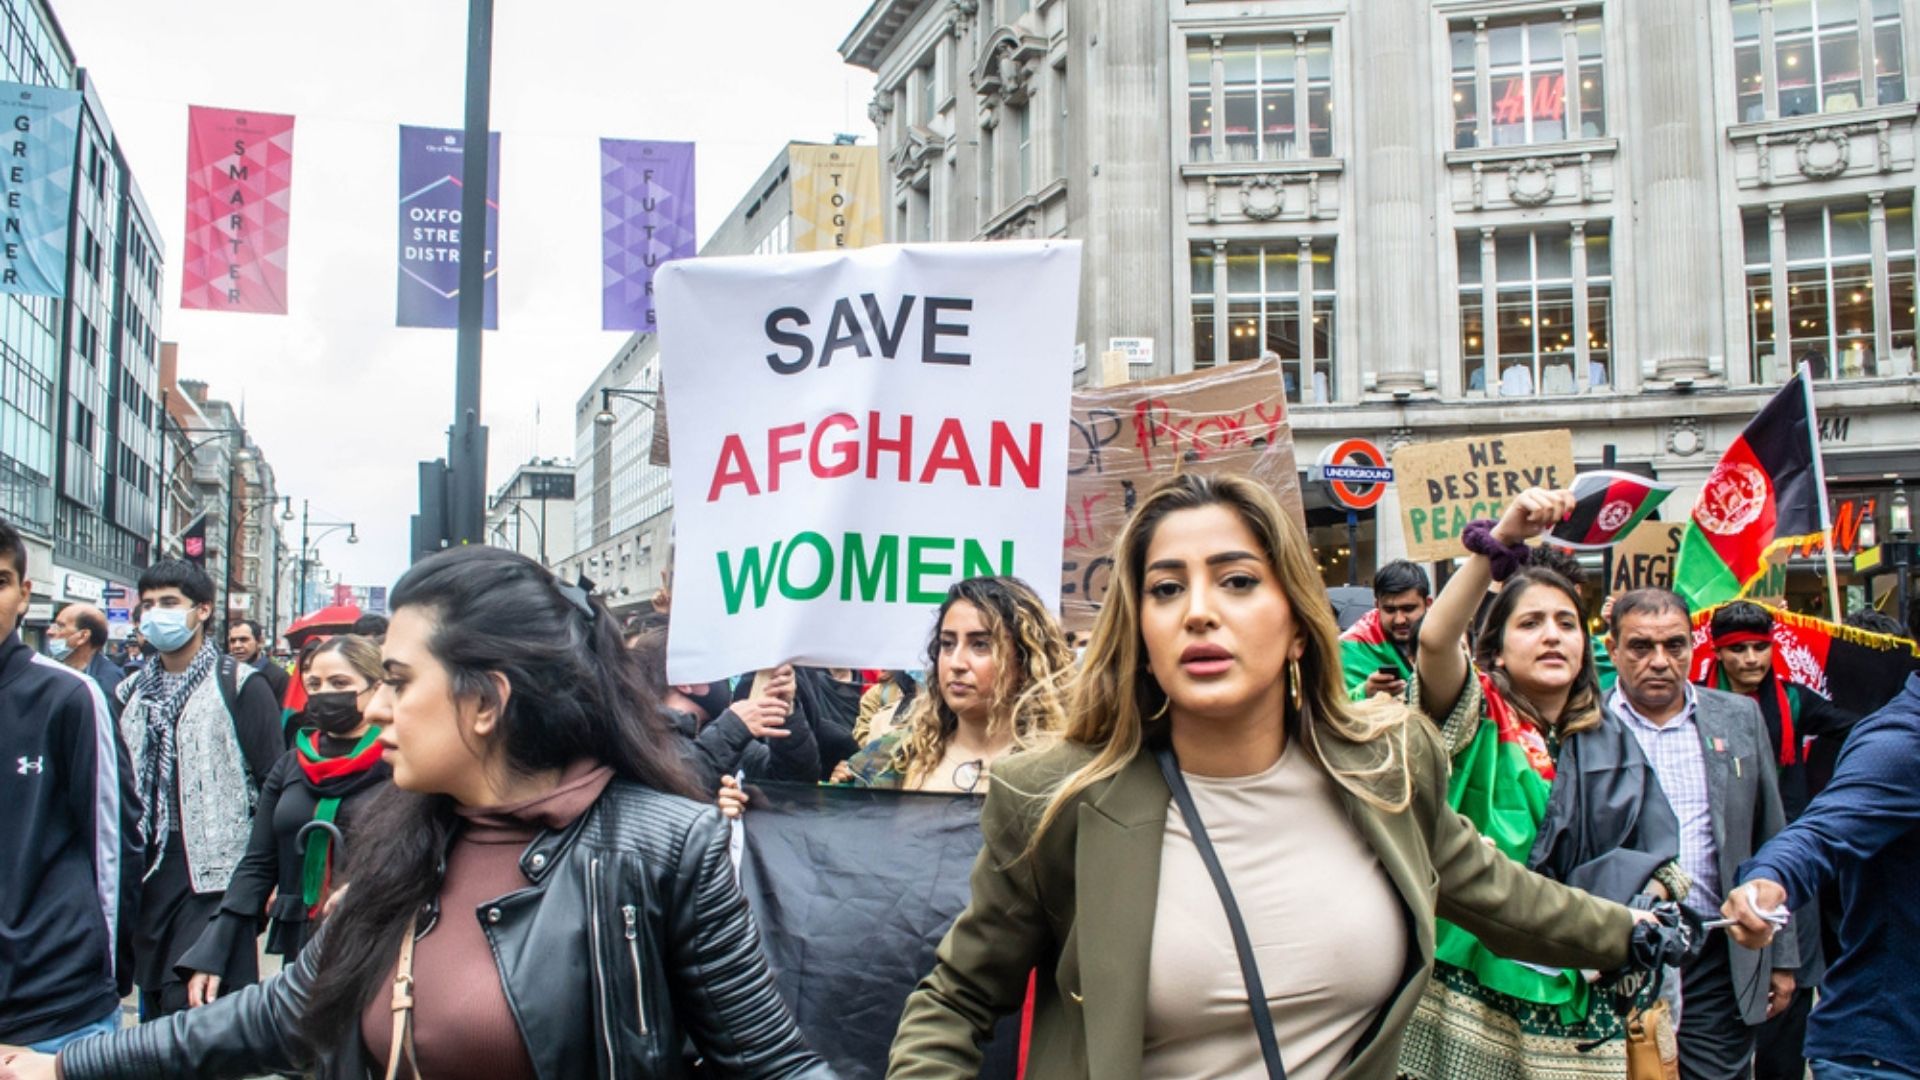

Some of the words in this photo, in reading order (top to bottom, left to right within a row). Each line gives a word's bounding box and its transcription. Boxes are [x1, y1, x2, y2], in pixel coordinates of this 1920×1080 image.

[3, 115, 30, 285] GREENER
[228, 140, 248, 304] SMARTER
[410, 207, 462, 224] OXFO
[413, 227, 460, 243] STRE
[830, 173, 846, 247] TOGE
[405, 246, 492, 264] DISTRT
[642, 169, 656, 325] FUTURE
[765, 293, 973, 375] SAVE
[707, 410, 1043, 502] AFGHAN
[1326, 467, 1391, 480] UNDERGROUND
[1426, 465, 1561, 505] DESERVE
[1468, 439, 1507, 468] WE
[716, 531, 1015, 615] WOMEN
